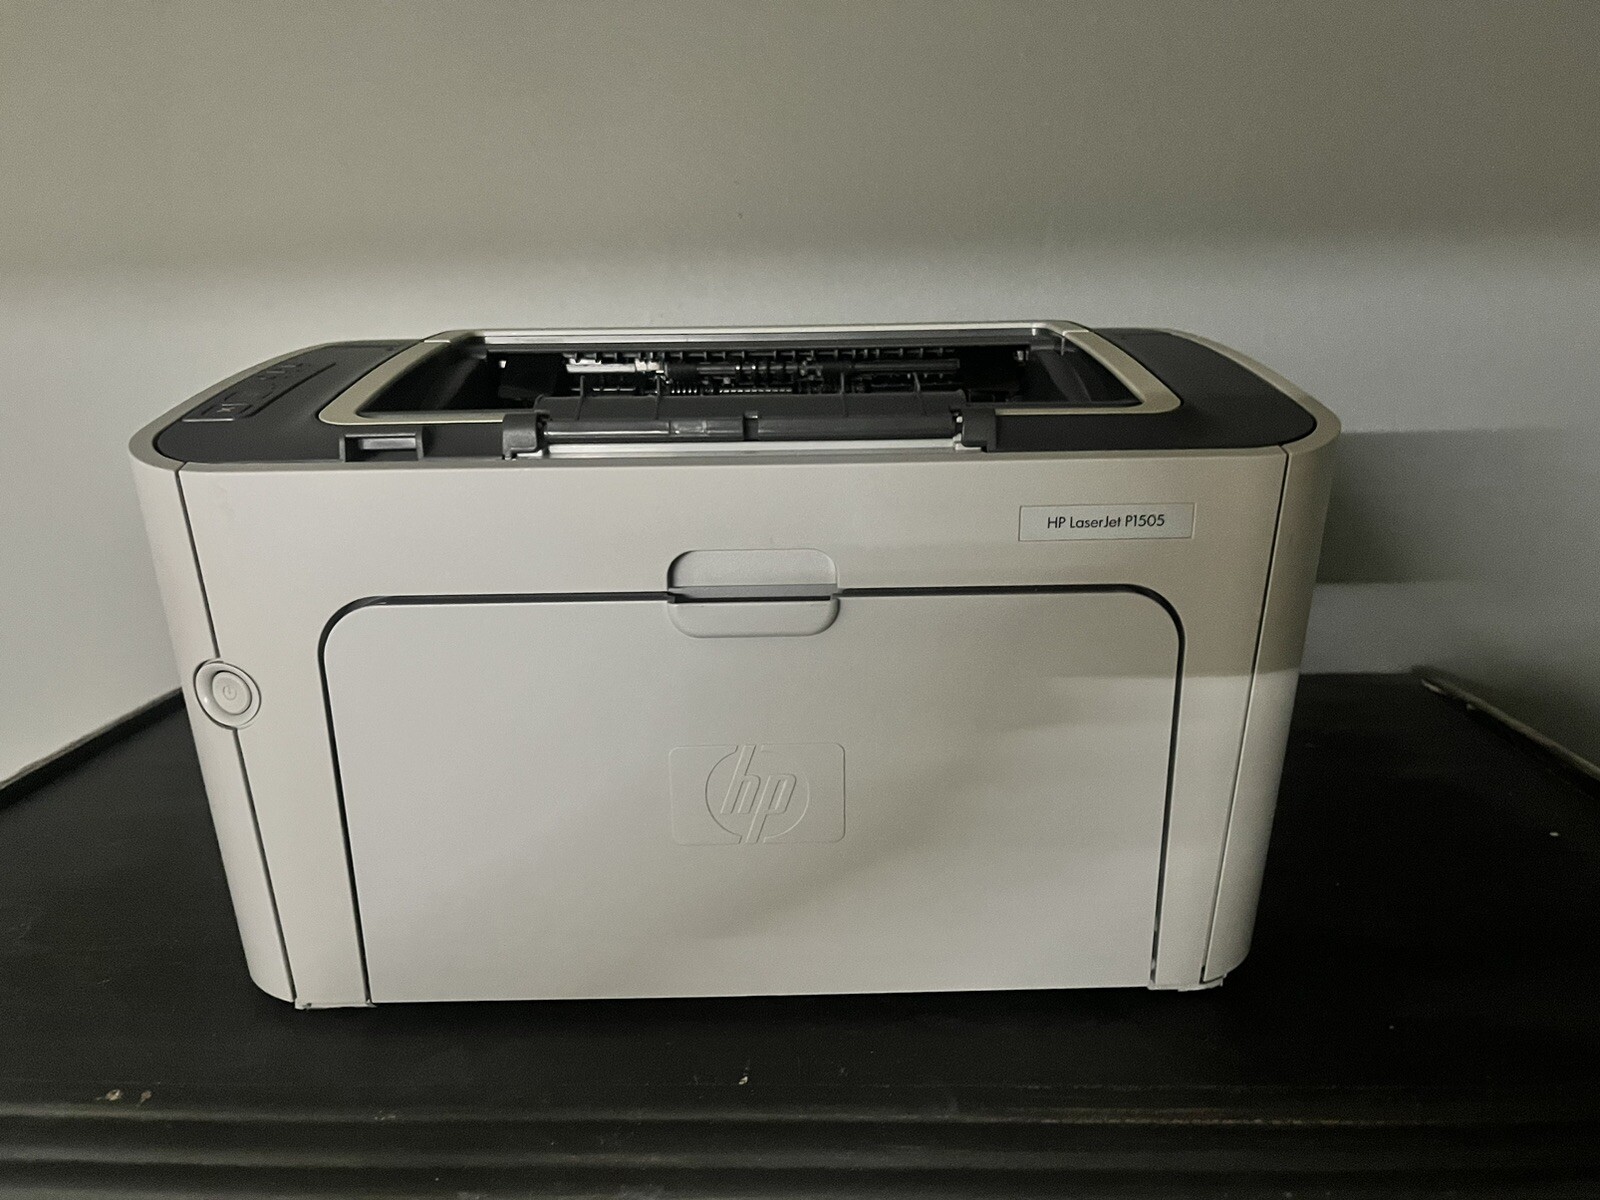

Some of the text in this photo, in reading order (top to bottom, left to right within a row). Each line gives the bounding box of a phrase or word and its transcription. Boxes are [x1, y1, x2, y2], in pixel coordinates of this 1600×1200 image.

[1047, 513, 1165, 529] HP LaserJet P1505
[720, 744, 797, 844] hp
